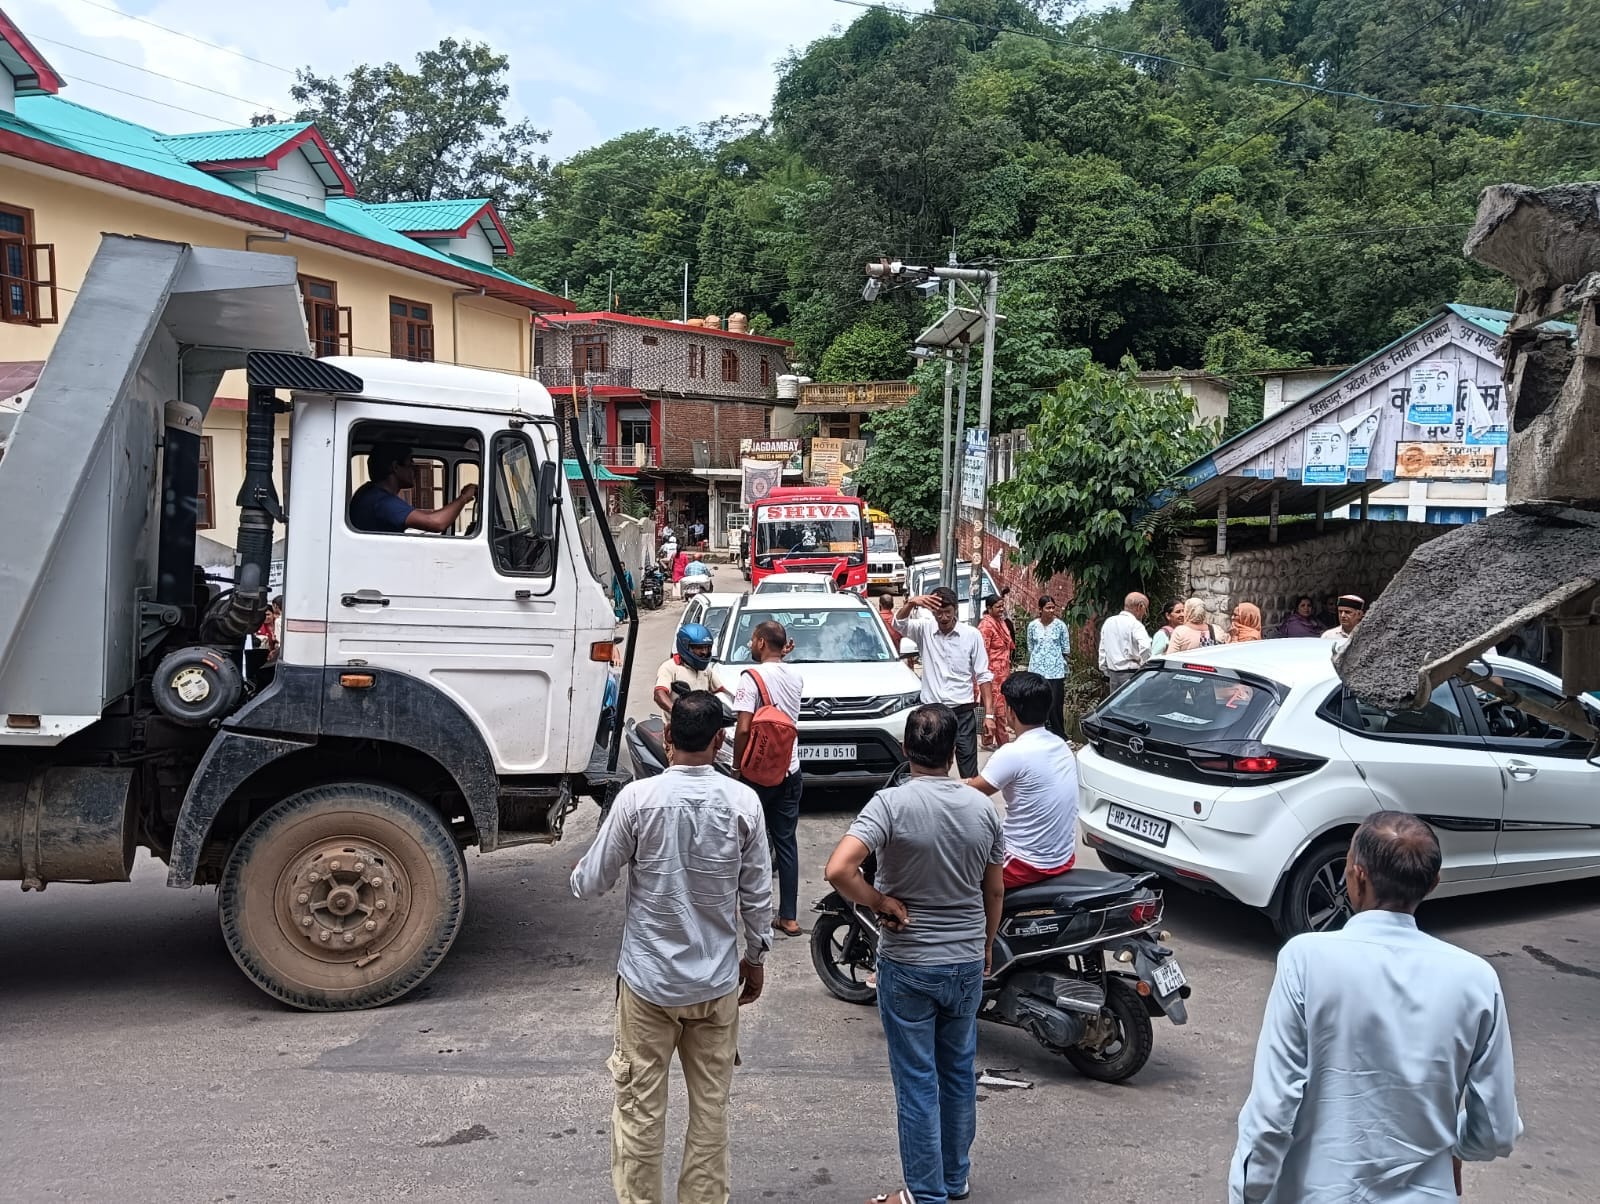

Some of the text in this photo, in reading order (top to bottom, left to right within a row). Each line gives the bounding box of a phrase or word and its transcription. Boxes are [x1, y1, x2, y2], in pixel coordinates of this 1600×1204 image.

[1459, 325, 1476, 342] उप
[1369, 362, 1391, 379] लोक
[1387, 341, 1420, 366] निर्माण
[1418, 323, 1451, 346] विभाग
[751, 441, 799, 452] JAGDAMBAY
[767, 505, 850, 519] SHIVA
[823, 745, 829, 758] B
[832, 745, 856, 758] 0510
[1114, 810, 1125, 825] HP
[1142, 819, 1165, 840] 5174
